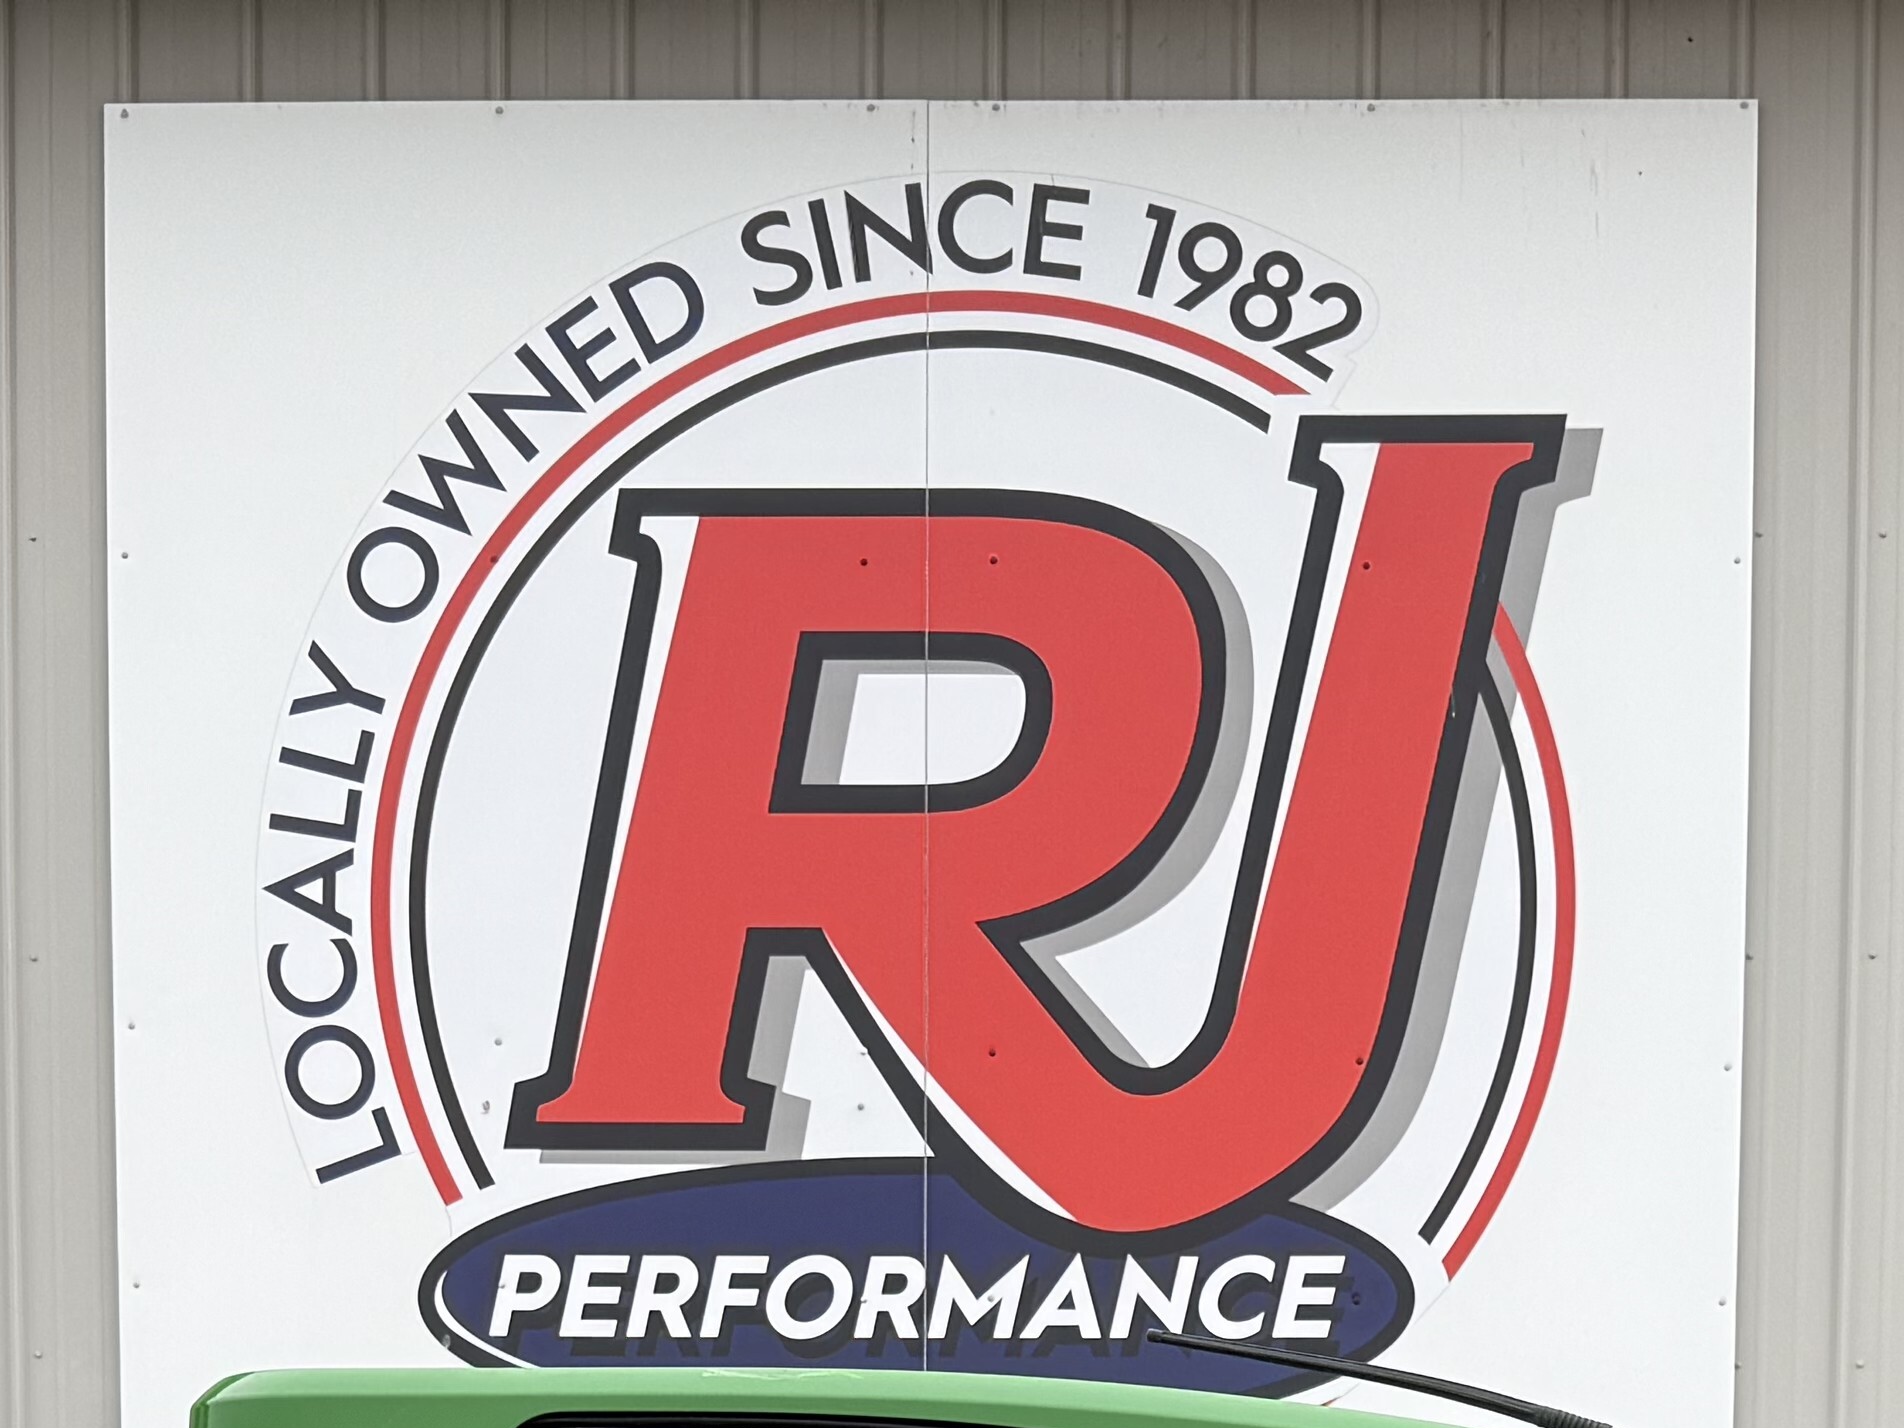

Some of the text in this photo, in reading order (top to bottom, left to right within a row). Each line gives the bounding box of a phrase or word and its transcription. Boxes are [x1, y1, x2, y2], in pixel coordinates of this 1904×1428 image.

[263, 180, 1361, 1183] LOCALLY OWNED SINCE 1982
[504, 415, 1566, 1251] RJ
[489, 1253, 1345, 1339] PERFORMANCE
